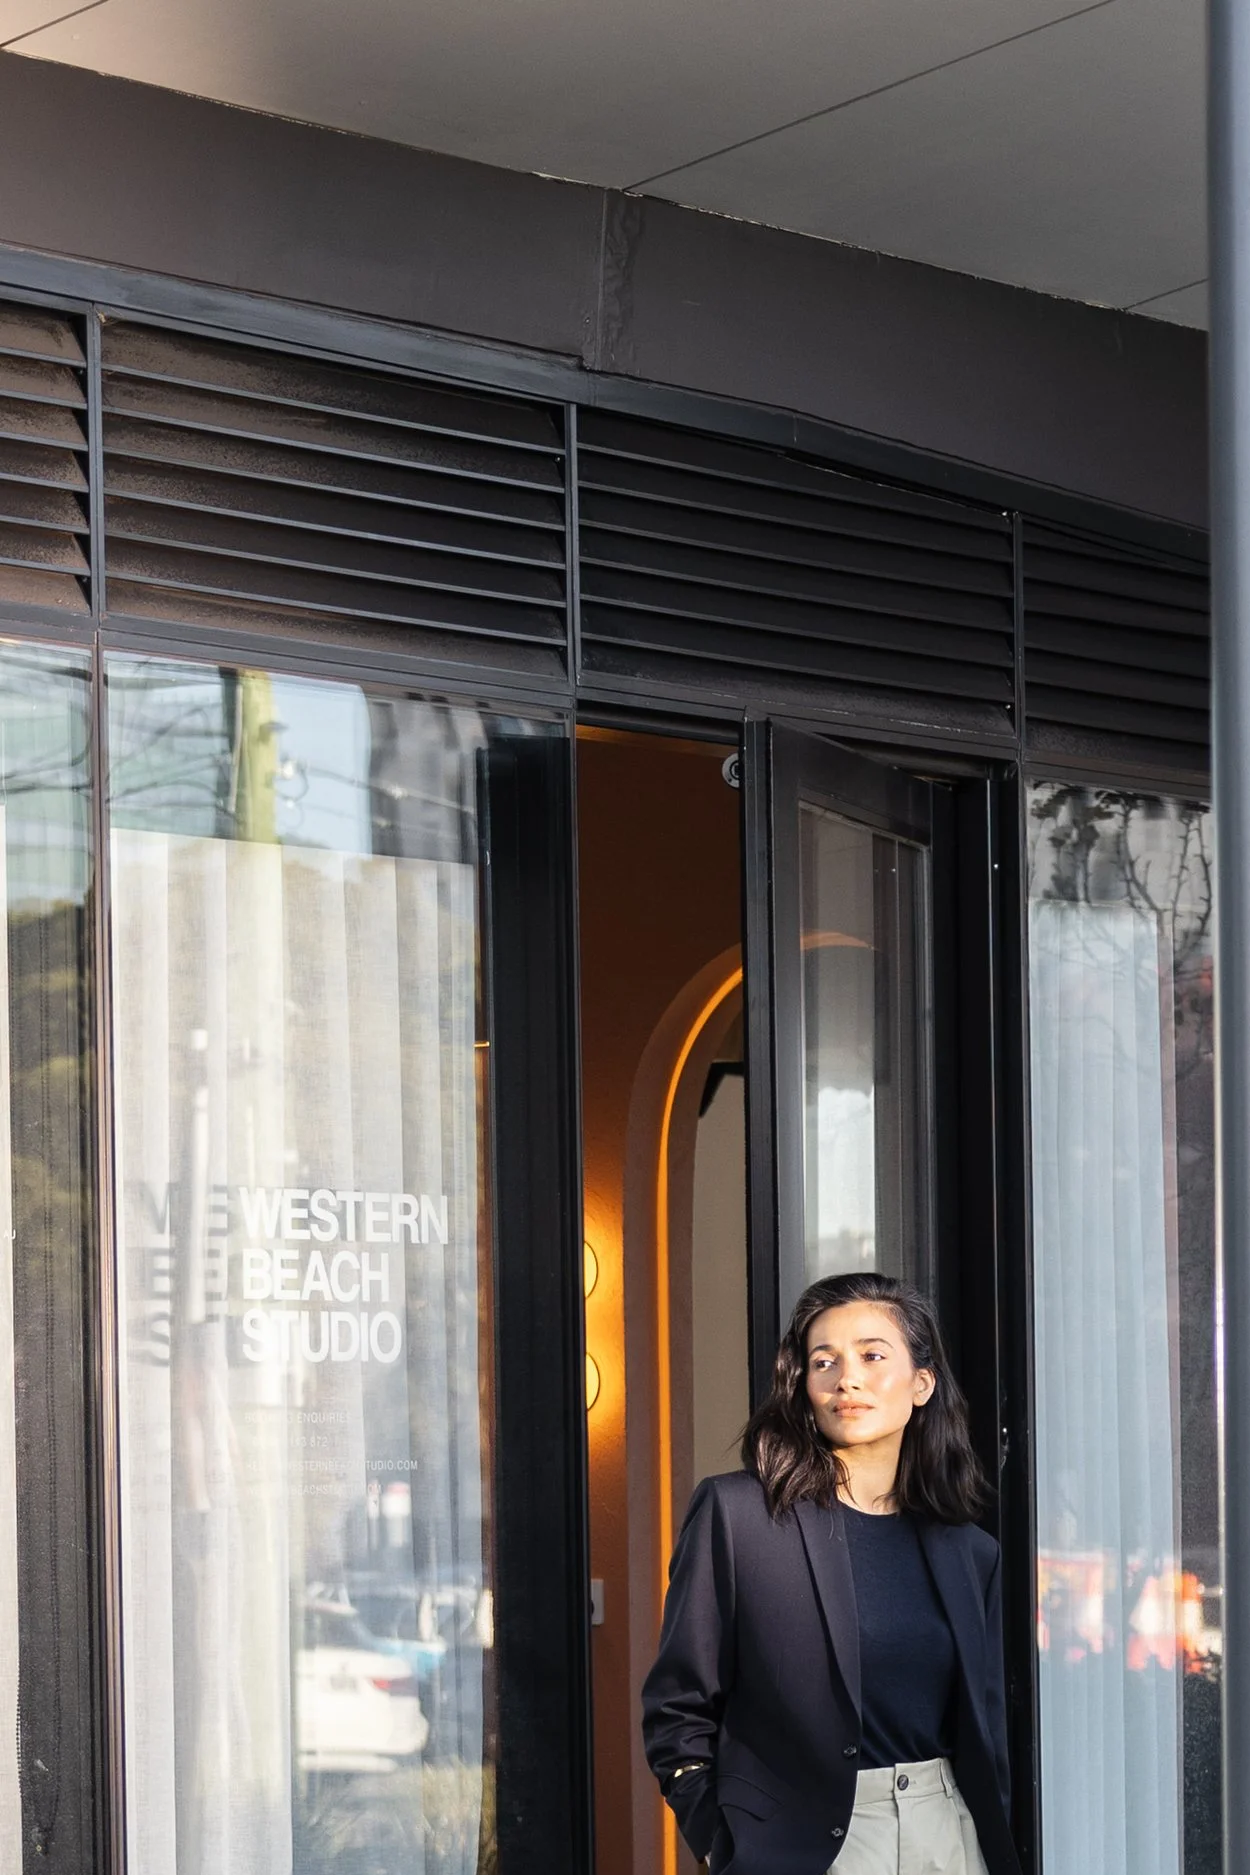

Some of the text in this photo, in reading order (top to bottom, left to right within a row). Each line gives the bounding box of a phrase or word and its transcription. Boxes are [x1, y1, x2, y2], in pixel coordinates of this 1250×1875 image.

[239, 1186, 448, 1245] WESTERN
[242, 1249, 389, 1302] BEACH
[242, 1308, 402, 1364] STUDIO
